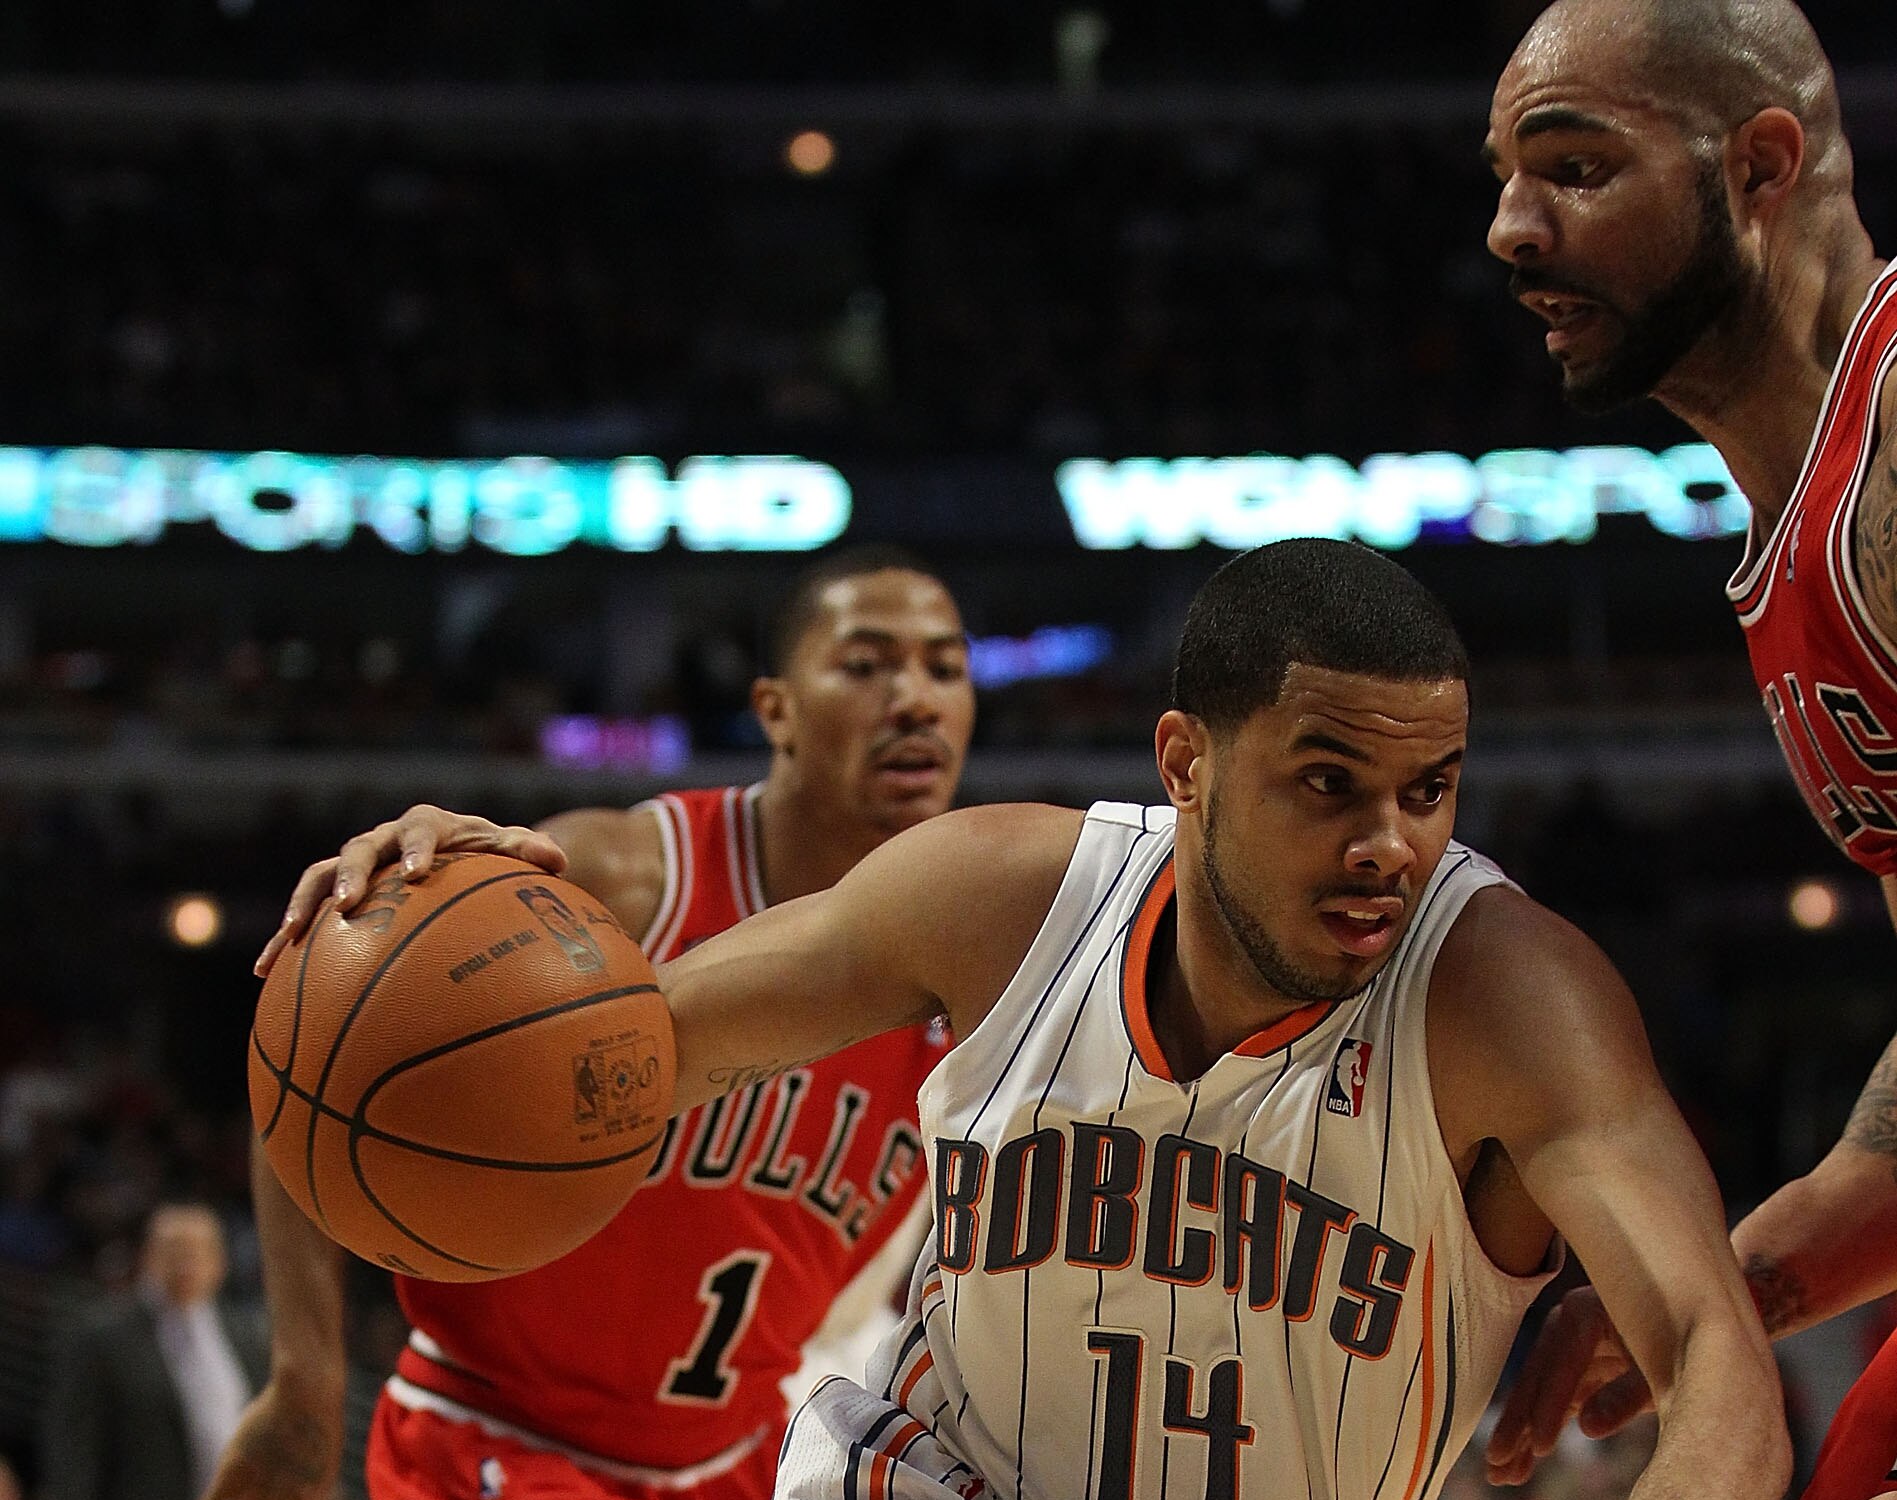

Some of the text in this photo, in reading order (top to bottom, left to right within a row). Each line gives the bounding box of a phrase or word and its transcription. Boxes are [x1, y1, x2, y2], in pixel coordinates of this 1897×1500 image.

[606, 454, 852, 552] HD
[1328, 1097, 1350, 1114] NBA
[936, 1120, 1416, 1362] BOBCATS
[657, 1247, 772, 1408] 1
